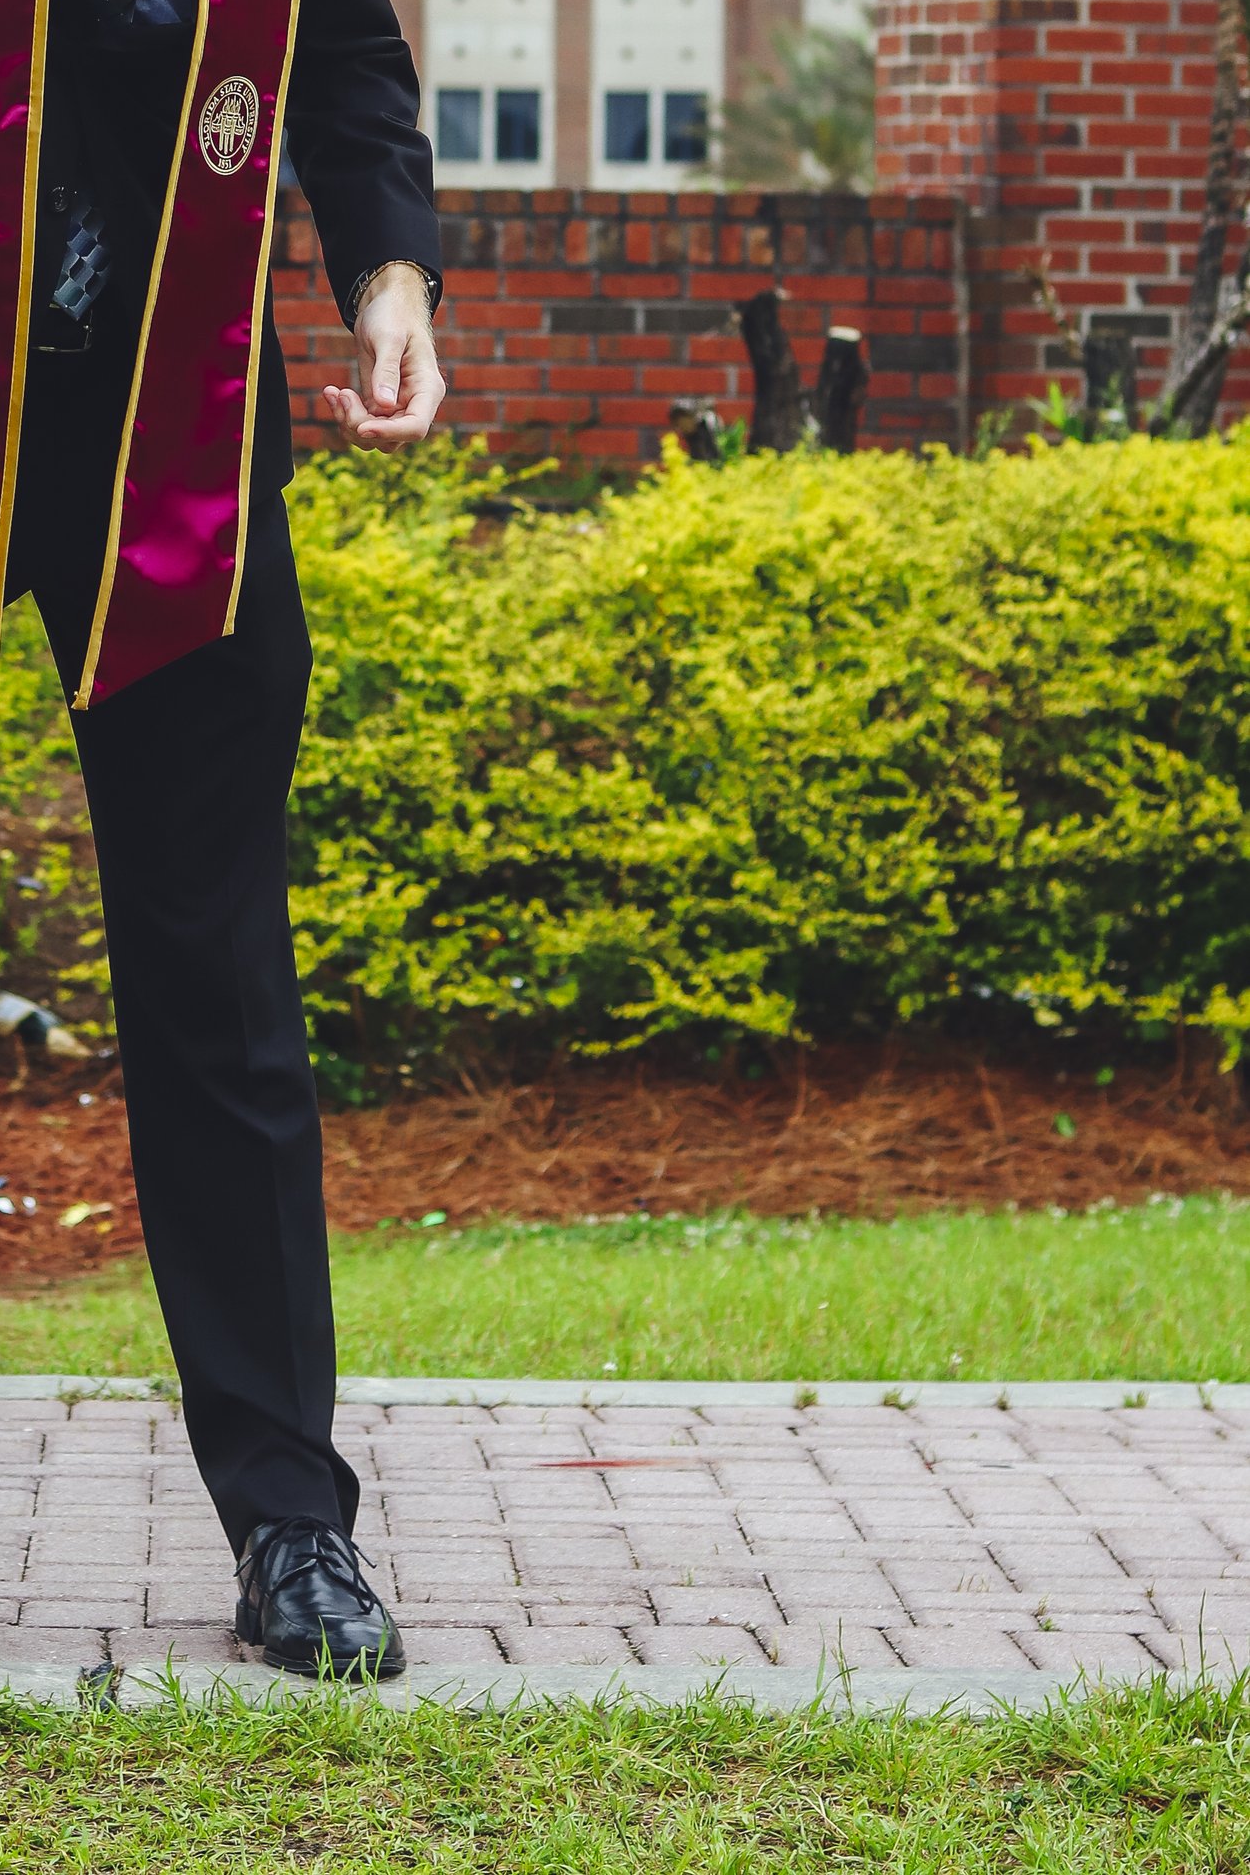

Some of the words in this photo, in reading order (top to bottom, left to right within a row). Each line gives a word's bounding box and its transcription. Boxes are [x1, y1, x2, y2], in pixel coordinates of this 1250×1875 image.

[203, 96, 220, 150] FLORIDA
[220, 82, 244, 97] STATE
[242, 89, 256, 154] UNIVERSITY
